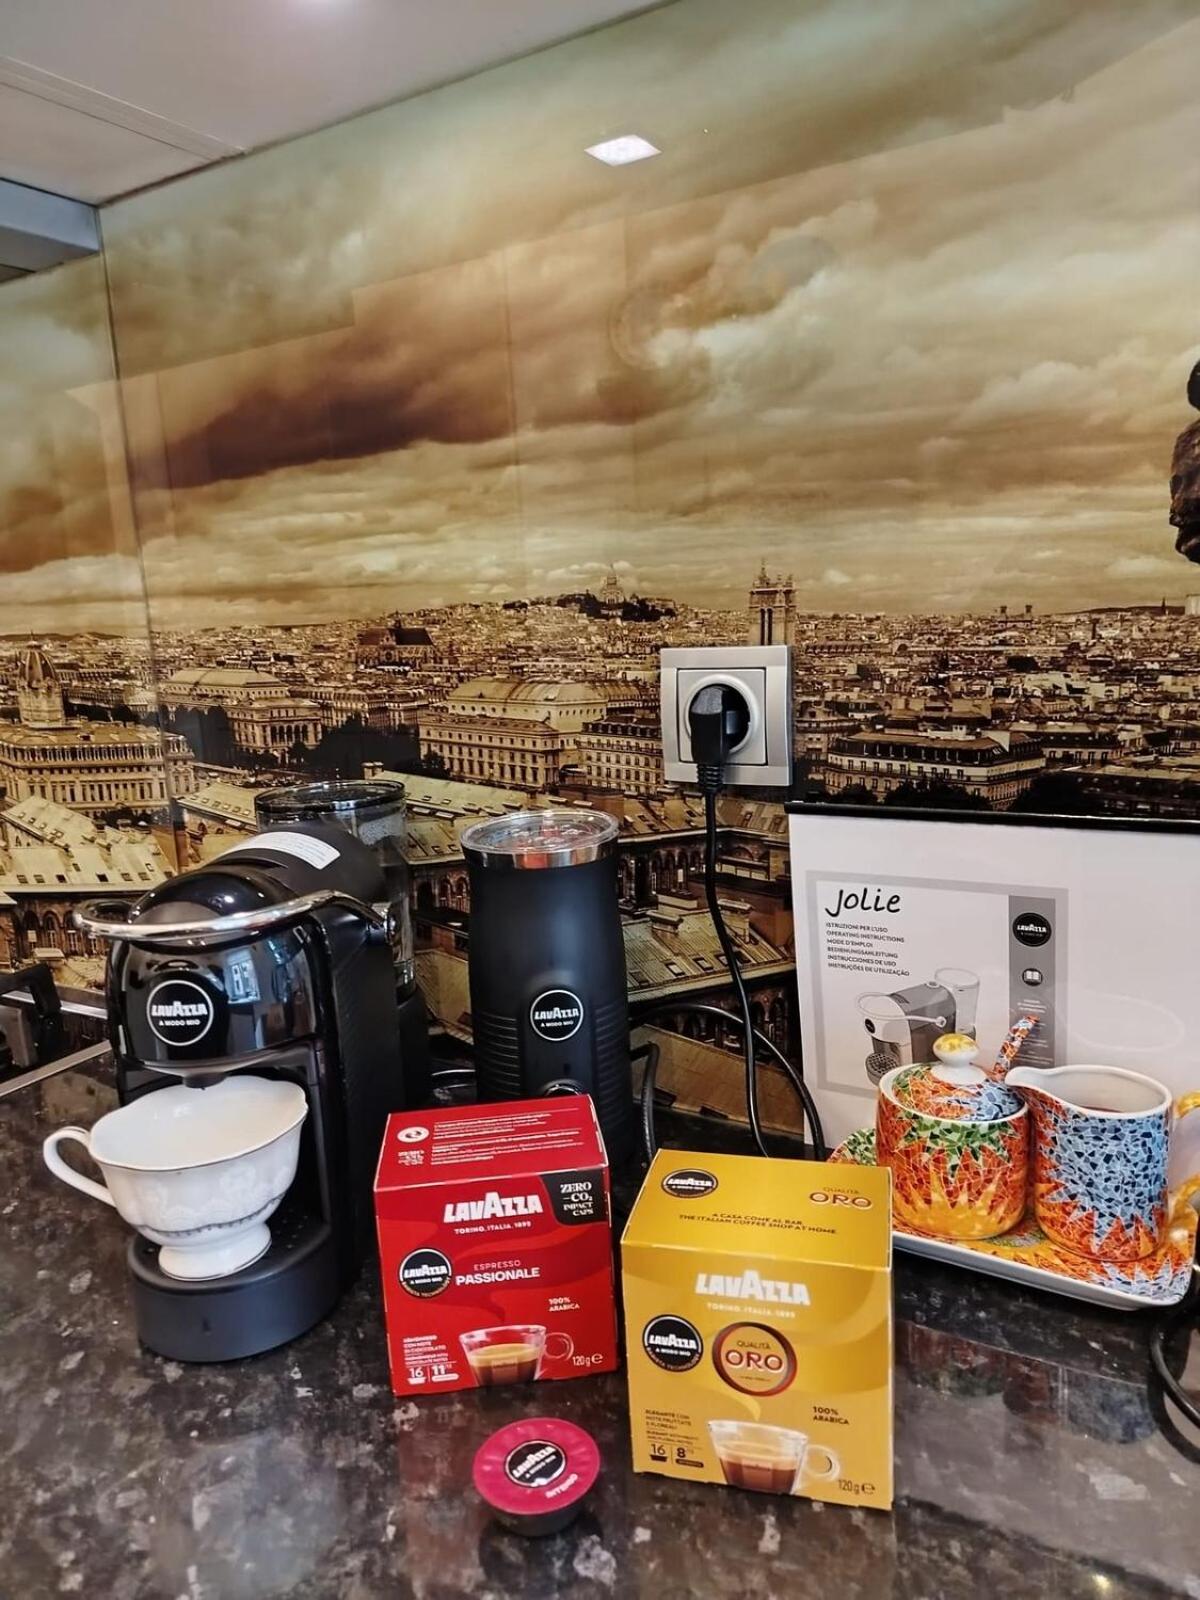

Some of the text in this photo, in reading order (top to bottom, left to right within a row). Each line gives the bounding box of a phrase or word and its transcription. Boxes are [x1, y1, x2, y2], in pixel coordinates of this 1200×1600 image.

[826, 922, 859, 930] ISTRUZIONI
[1017, 923, 1047, 933] LAVAZZA
[826, 930, 905, 943] OPERATING INSTRUCTIONS
[845, 940, 873, 948] D'EMPLOI
[828, 955, 875, 964] INSTRUCCIONES
[874, 967, 910, 976] UTILIZAÇÃO
[151, 1001, 208, 1017] LAVAZZA
[534, 1007, 580, 1020] LAVAZZA
[667, 1177, 713, 1187] LAVAZZA
[560, 1182, 593, 1194] ZERO
[809, 1191, 872, 1209] ORO
[443, 1192, 544, 1223] LAVAZZA
[563, 1202, 593, 1211] IMPACT
[572, 1208, 594, 1217] CAPS
[696, 1216, 732, 1224] ITALIAN
[733, 1219, 766, 1227] COFFEE
[404, 1264, 448, 1278] LAVAZZA
[473, 1260, 521, 1271] ESPRESSO
[455, 1267, 540, 1286] PASSIONALE
[695, 1270, 811, 1306] LAVAZZA
[548, 1297, 571, 1305] 100%
[549, 1303, 580, 1312] ARABICA
[649, 1333, 697, 1350] LAVAZZA
[725, 1350, 784, 1372] ORO
[409, 1367, 424, 1378] 16
[813, 1406, 839, 1416] 100%
[813, 1415, 850, 1425] ARABICA
[651, 1443, 666, 1455] 16
[676, 1447, 686, 1458] 8
[512, 1446, 556, 1478] LAVAZZA
